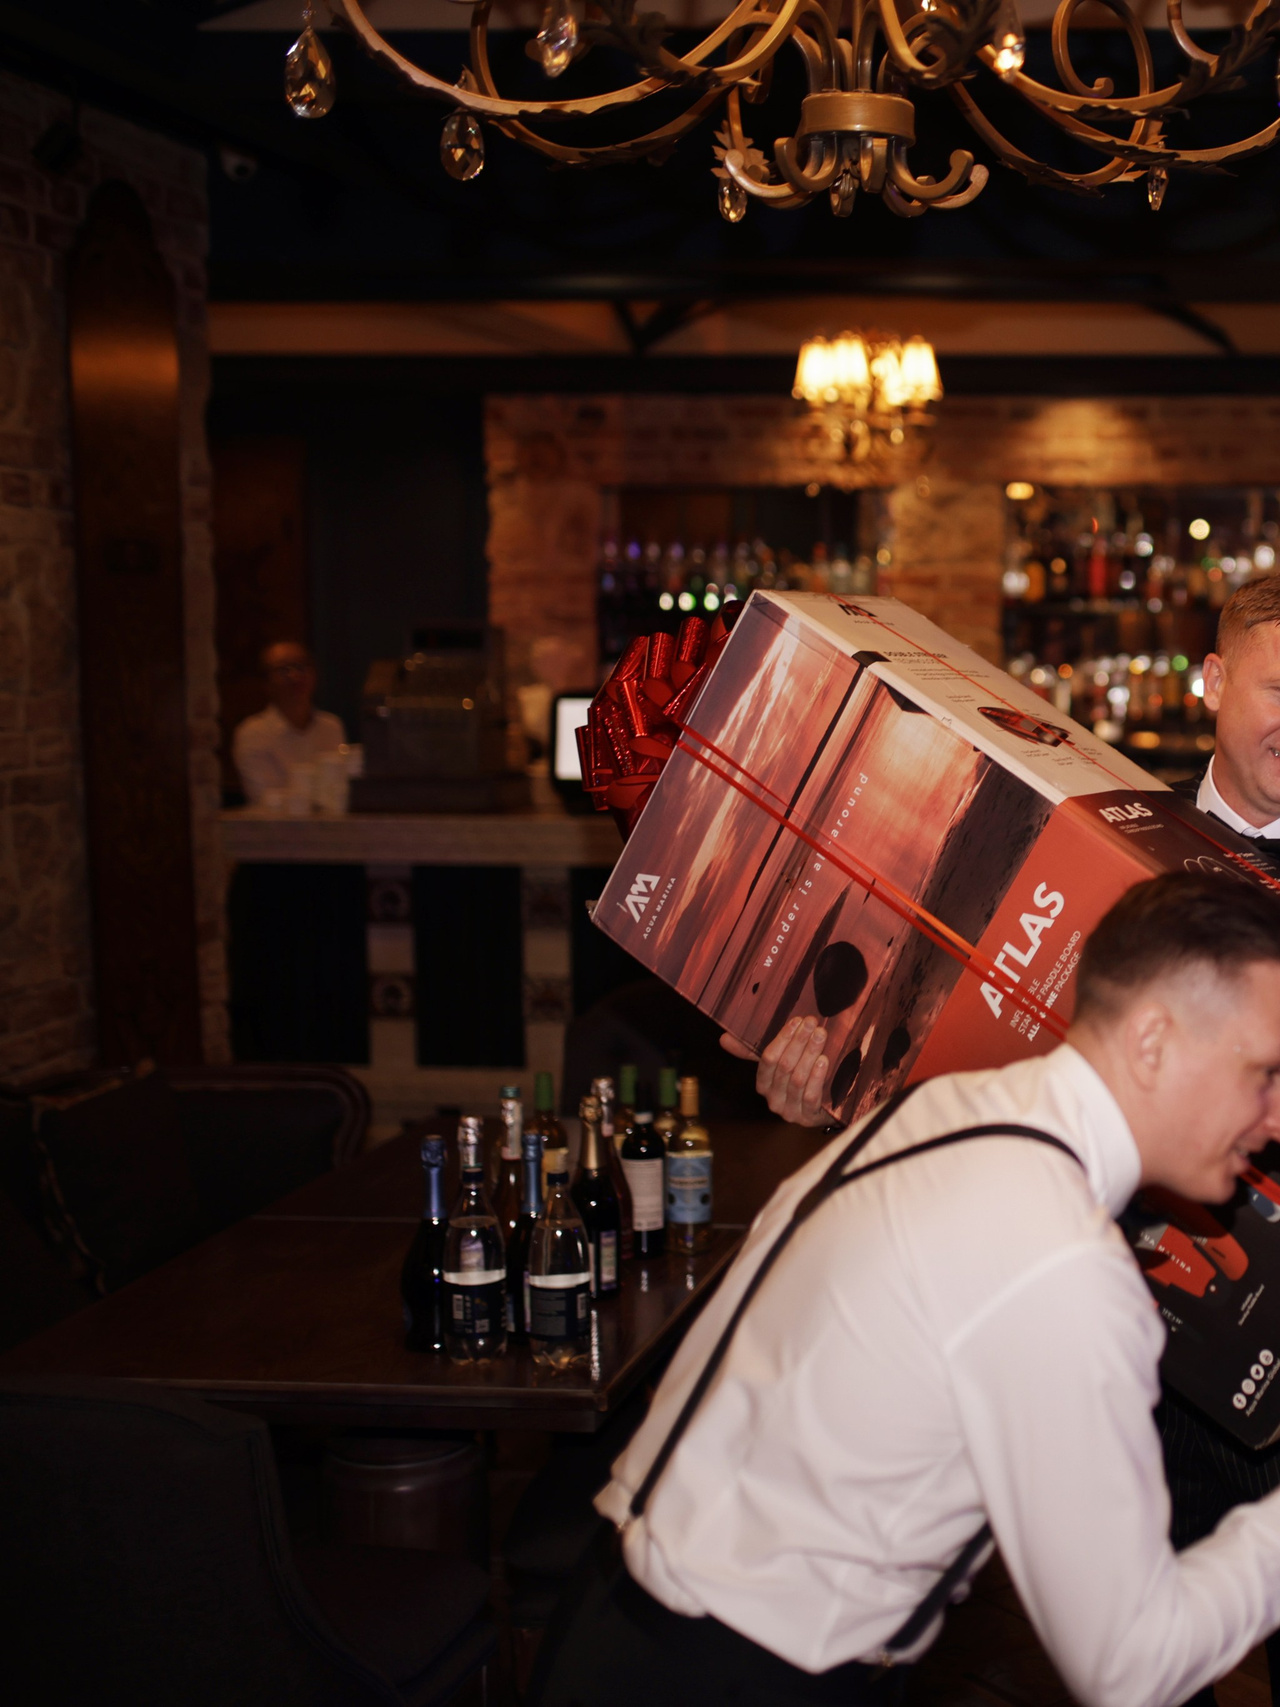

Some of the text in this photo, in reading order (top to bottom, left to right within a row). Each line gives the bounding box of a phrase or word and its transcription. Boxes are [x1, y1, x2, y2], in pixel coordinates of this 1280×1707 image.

[1099, 802, 1153, 823] ATLAS
[763, 772, 869, 967] wonder is al-around
[643, 877, 677, 940] AQUA MARINA
[980, 881, 1065, 1019] ATLAS
[1039, 960, 1064, 996] PADDLE
[1059, 930, 1081, 963] BOARD
[1054, 951, 1081, 992] PACKAGE
[1009, 978, 1041, 1028] INFLTBLE
